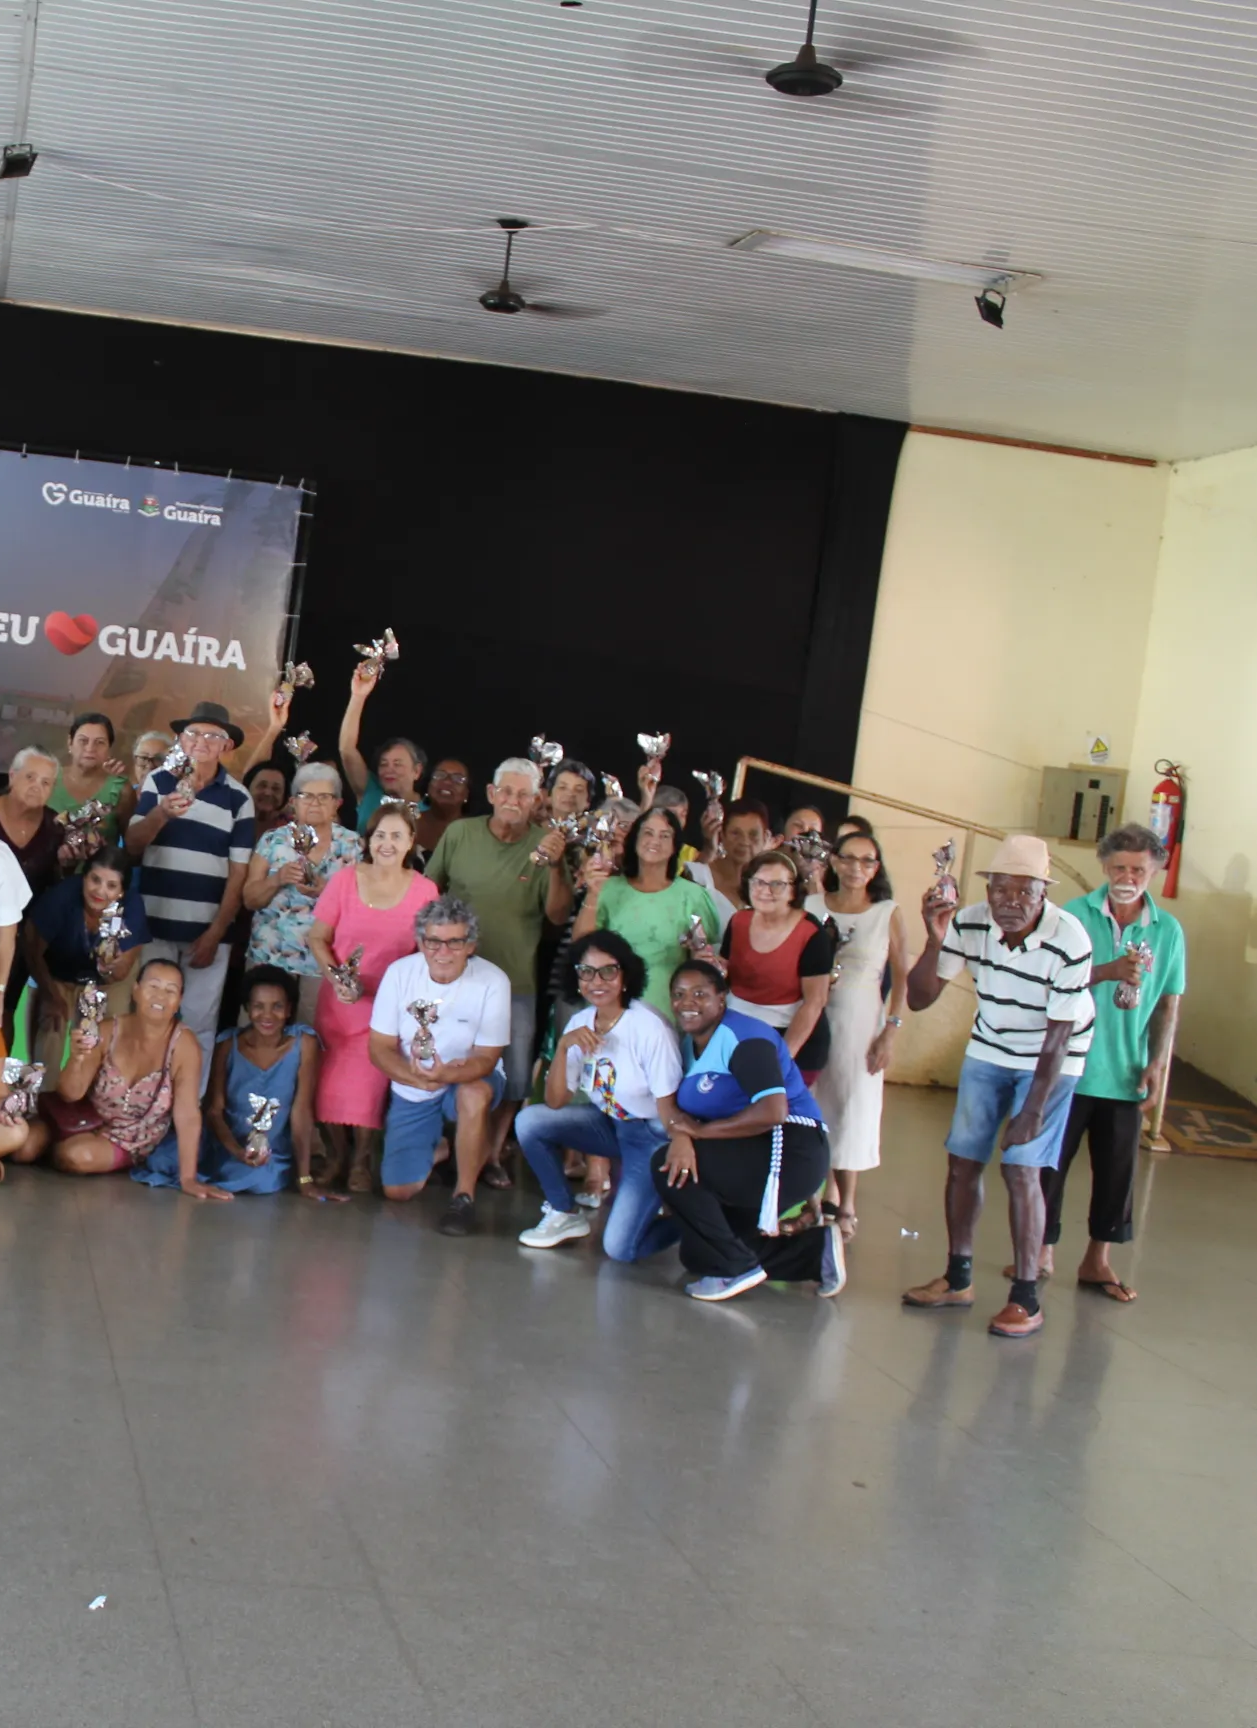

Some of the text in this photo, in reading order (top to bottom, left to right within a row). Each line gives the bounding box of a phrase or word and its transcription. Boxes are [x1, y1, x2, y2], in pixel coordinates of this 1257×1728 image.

[68, 489, 130, 511] Guaíra
[163, 505, 222, 527] Guaíra
[98, 624, 246, 671] GUAÍRA
